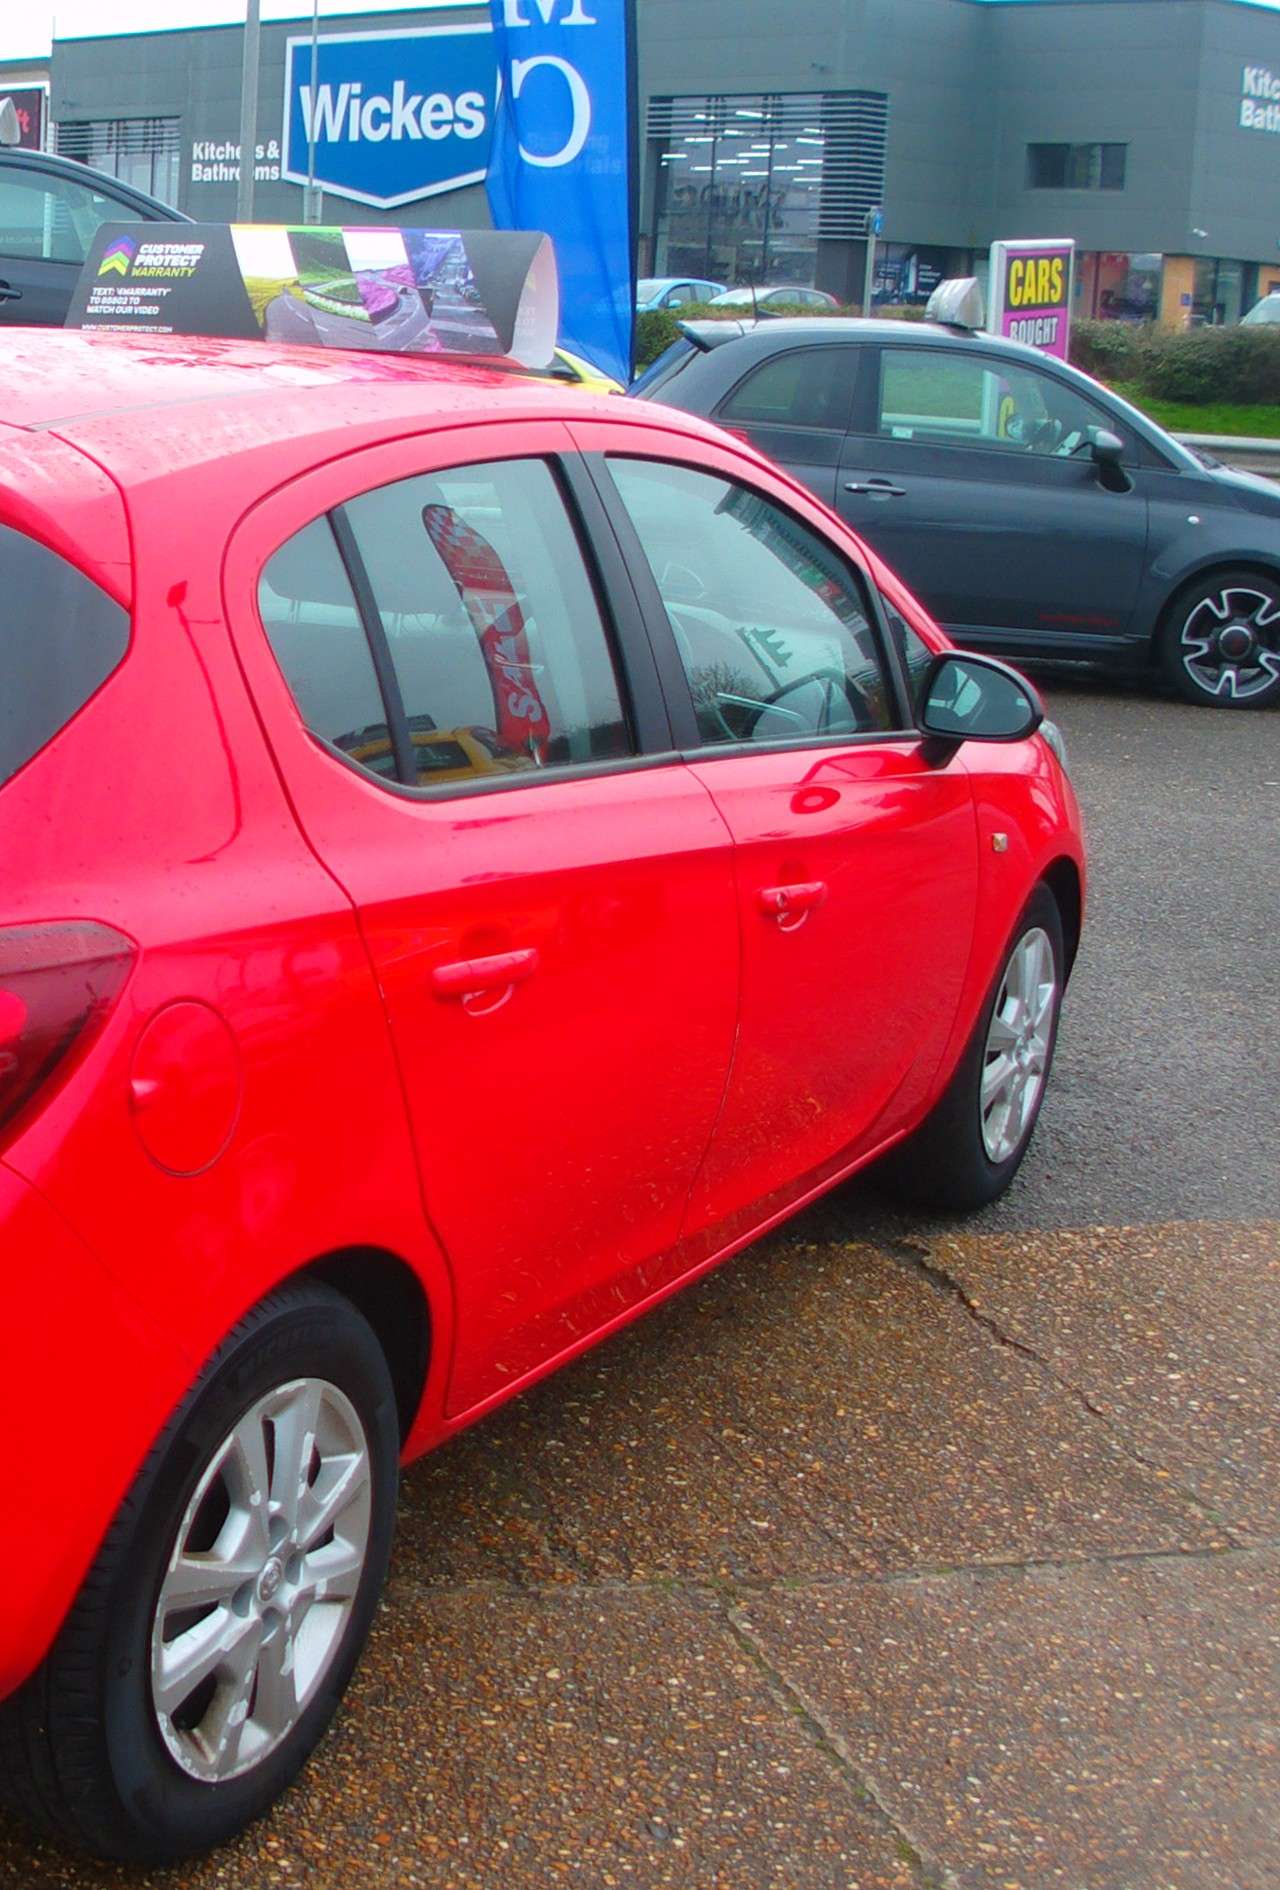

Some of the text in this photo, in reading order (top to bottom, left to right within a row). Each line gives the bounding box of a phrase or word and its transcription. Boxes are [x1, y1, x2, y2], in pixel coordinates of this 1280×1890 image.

[299, 80, 485, 143] Wickes
[192, 140, 280, 161] Kitches &
[192, 162, 280, 182] Bathroms
[139, 244, 205, 255] CUSTOMER
[134, 255, 201, 267] PROTECT
[131, 267, 197, 278] WARRANTY
[1009, 258, 1063, 306] CARS
[1009, 317, 1058, 346] BOUGHT
